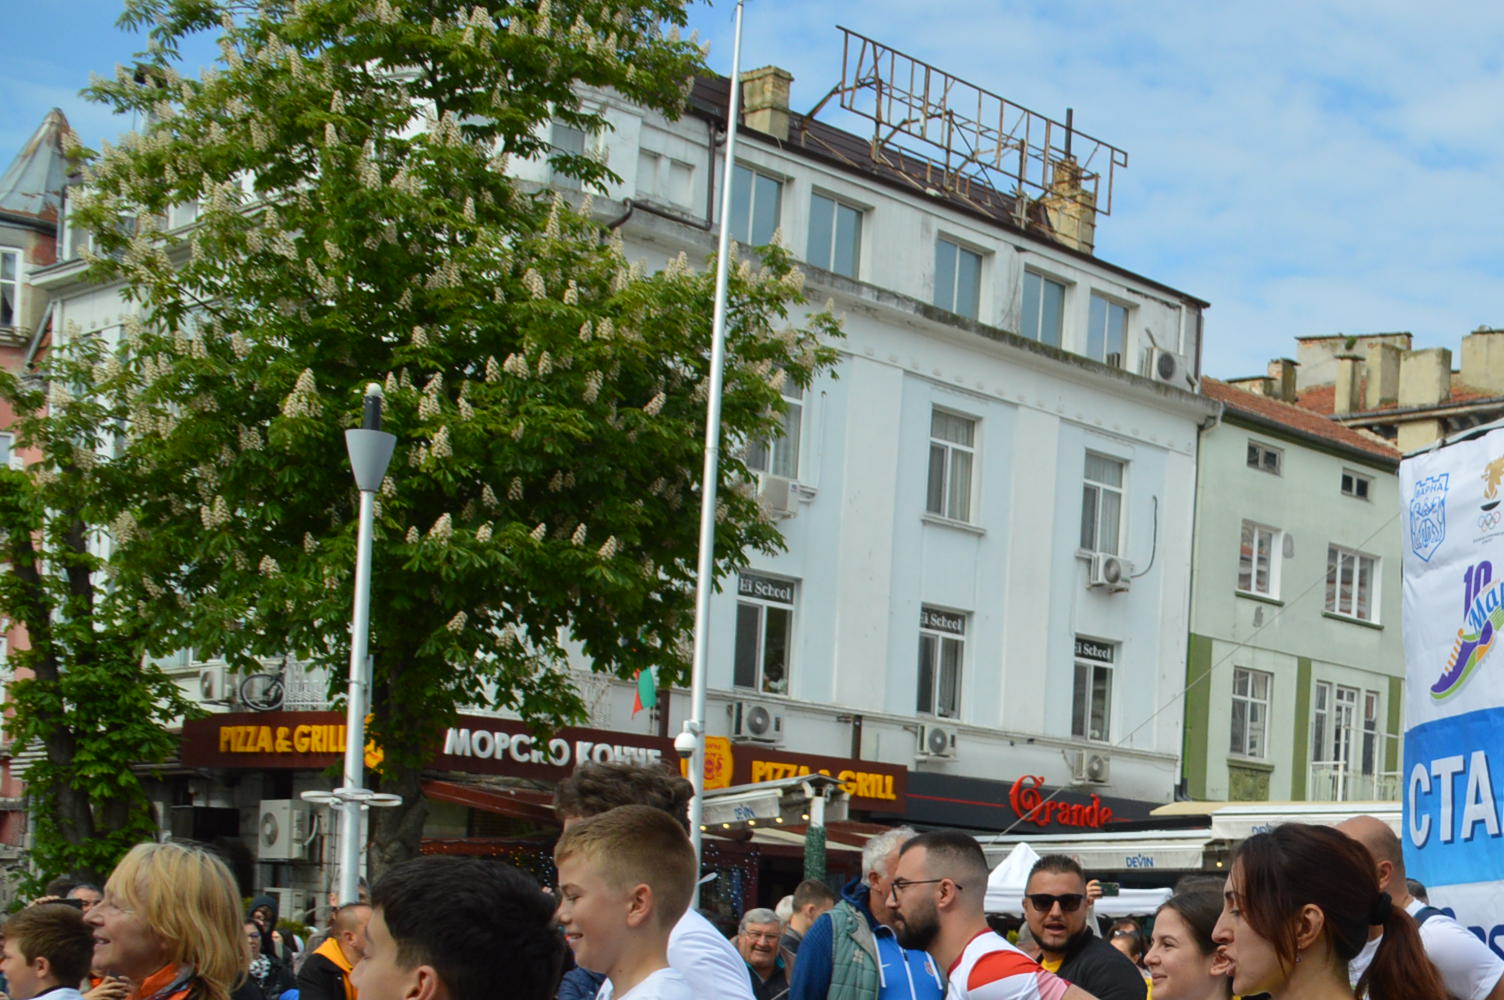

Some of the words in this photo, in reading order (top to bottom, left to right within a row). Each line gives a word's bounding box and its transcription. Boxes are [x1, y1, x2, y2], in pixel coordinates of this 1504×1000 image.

[755, 582, 791, 600] School
[1464, 560, 1492, 622] 10
[931, 614, 961, 633] School
[219, 726, 274, 752] PIZZA
[275, 726, 293, 752] &
[294, 725, 347, 753] GRILL
[837, 770, 896, 800] GRILL
[1009, 774, 1113, 828] Grande
[1125, 854, 1154, 868] DEVIN
